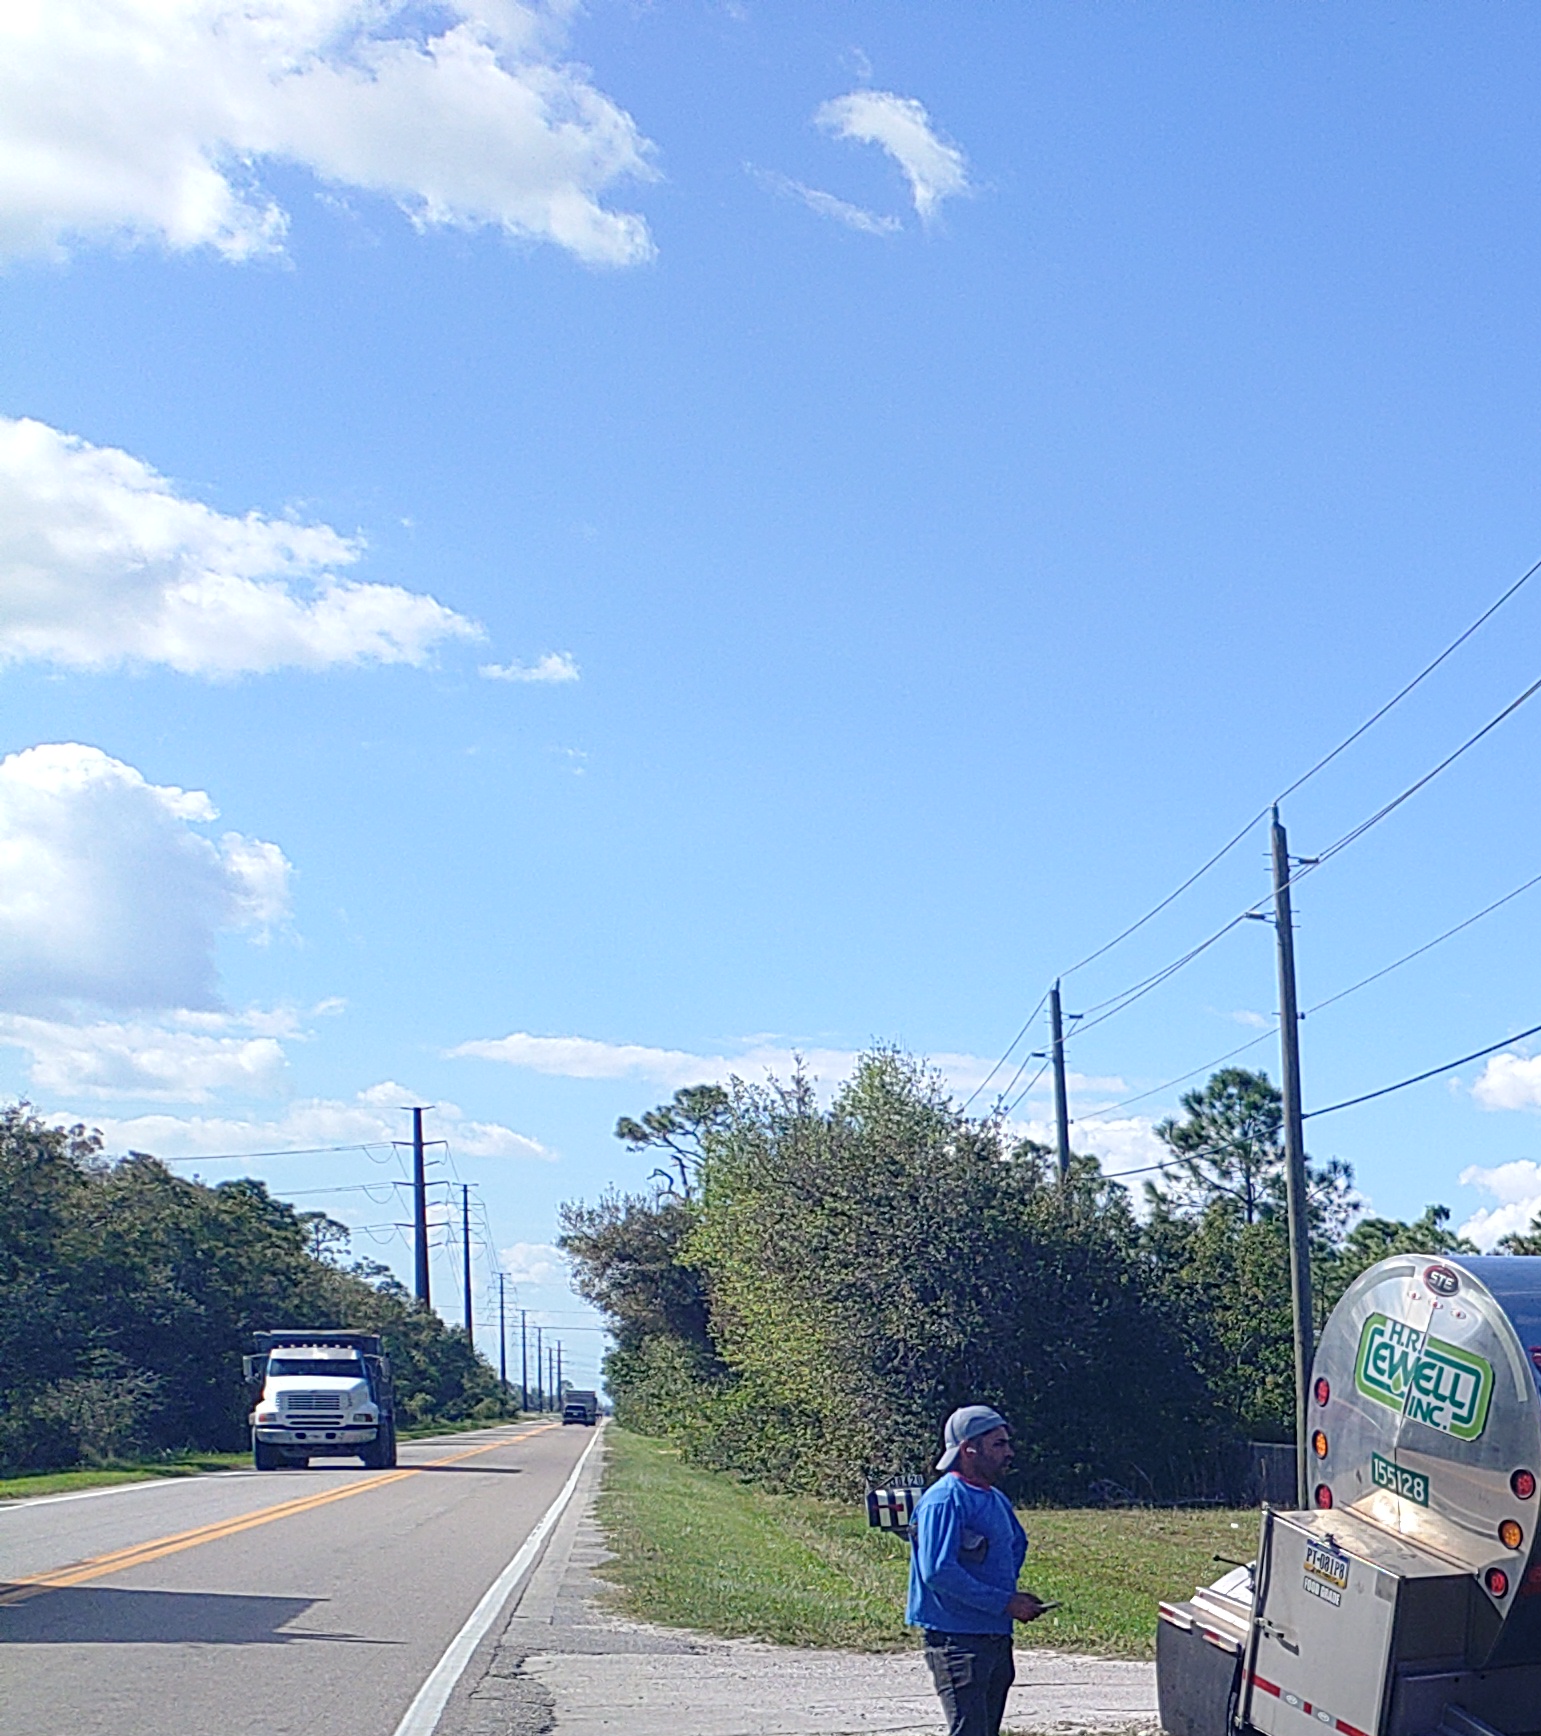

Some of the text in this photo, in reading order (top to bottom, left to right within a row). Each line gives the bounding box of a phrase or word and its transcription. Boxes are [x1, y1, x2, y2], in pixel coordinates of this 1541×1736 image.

[1372, 1341, 1466, 1410] EWELL
[1408, 1395, 1448, 1430] INC.
[1373, 1458, 1425, 1501] 155128
